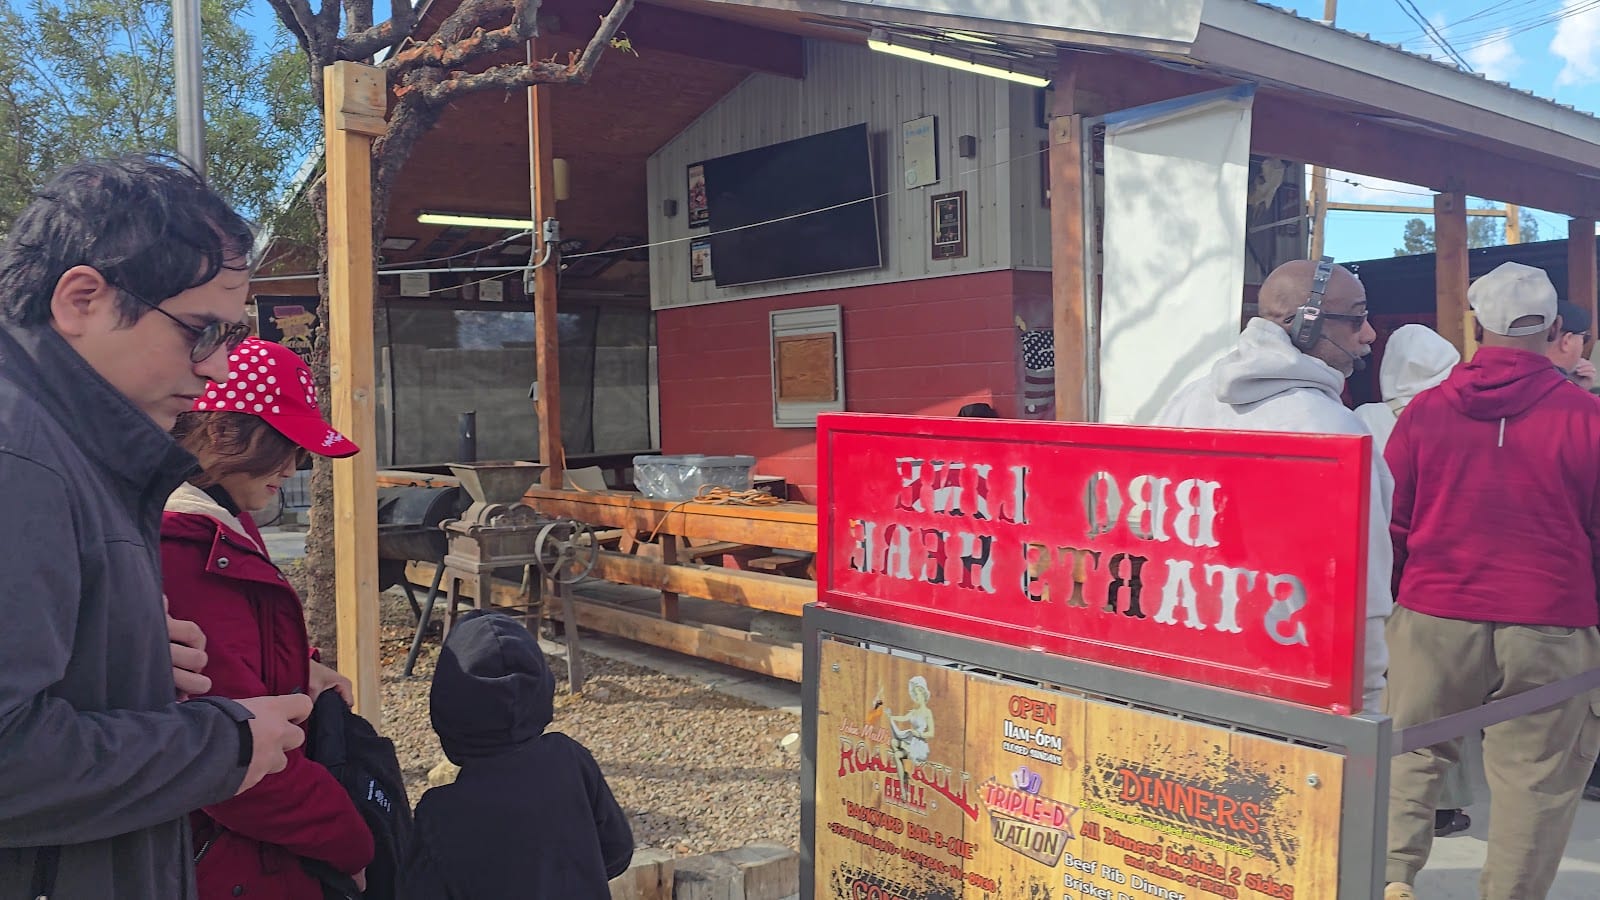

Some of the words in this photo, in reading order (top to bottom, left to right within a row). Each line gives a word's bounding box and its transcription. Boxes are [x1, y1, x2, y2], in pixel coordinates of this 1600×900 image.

[1008, 694, 1057, 726] OPEN
[1003, 718, 1062, 752] 11AM-6PM
[884, 776, 928, 812] GRLL
[986, 784, 1065, 828] TRIPLE-D
[1119, 768, 1260, 834] DINNERS
[993, 819, 1060, 856] NATION
[1080, 821, 1101, 841] All
[1166, 845, 1225, 880] include
[1228, 865, 1242, 886] 2
[1064, 852, 1098, 875] Beef
[1101, 864, 1126, 884] Rib
[1130, 873, 1186, 900] Dinner
[1064, 873, 1112, 900] Brisket
